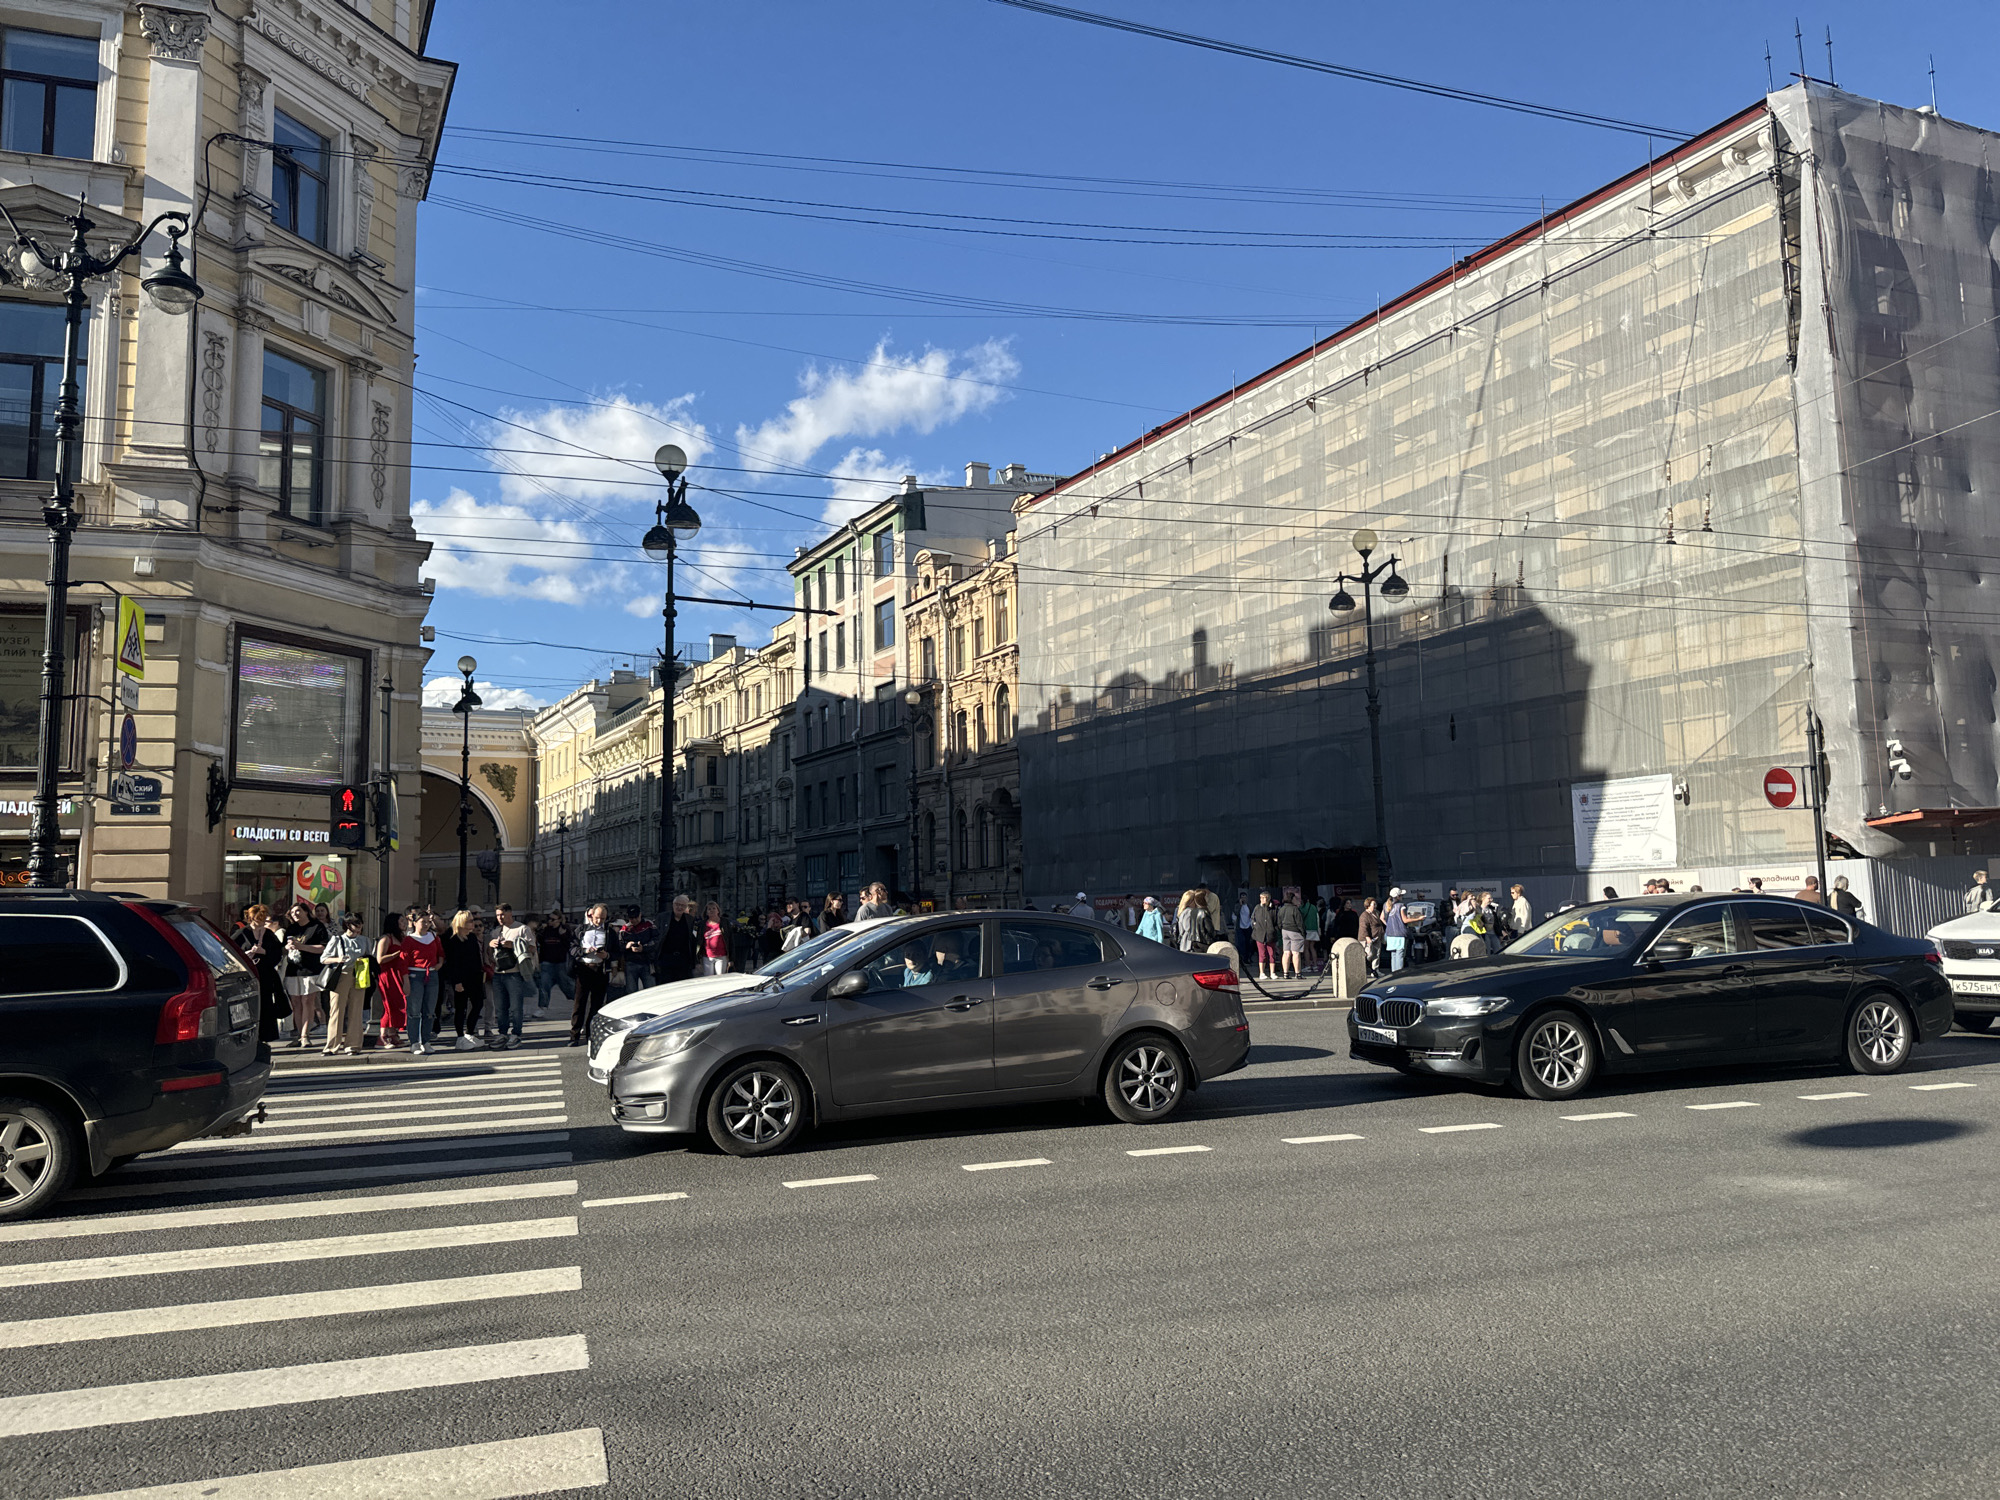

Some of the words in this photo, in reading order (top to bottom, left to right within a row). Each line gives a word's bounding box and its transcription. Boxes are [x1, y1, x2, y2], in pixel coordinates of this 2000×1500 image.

[0, 636, 30, 645] УЗЕЙ
[0, 648, 26, 657] ЛИЙ
[134, 784, 153, 792] СКИЙ
[131, 805, 140, 813] 16
[236, 826, 287, 840] СЛАДОСТИ
[289, 829, 301, 841] СО
[303, 830, 330, 843] ВСЕГО
[1747, 874, 1800, 883] Шоладница
